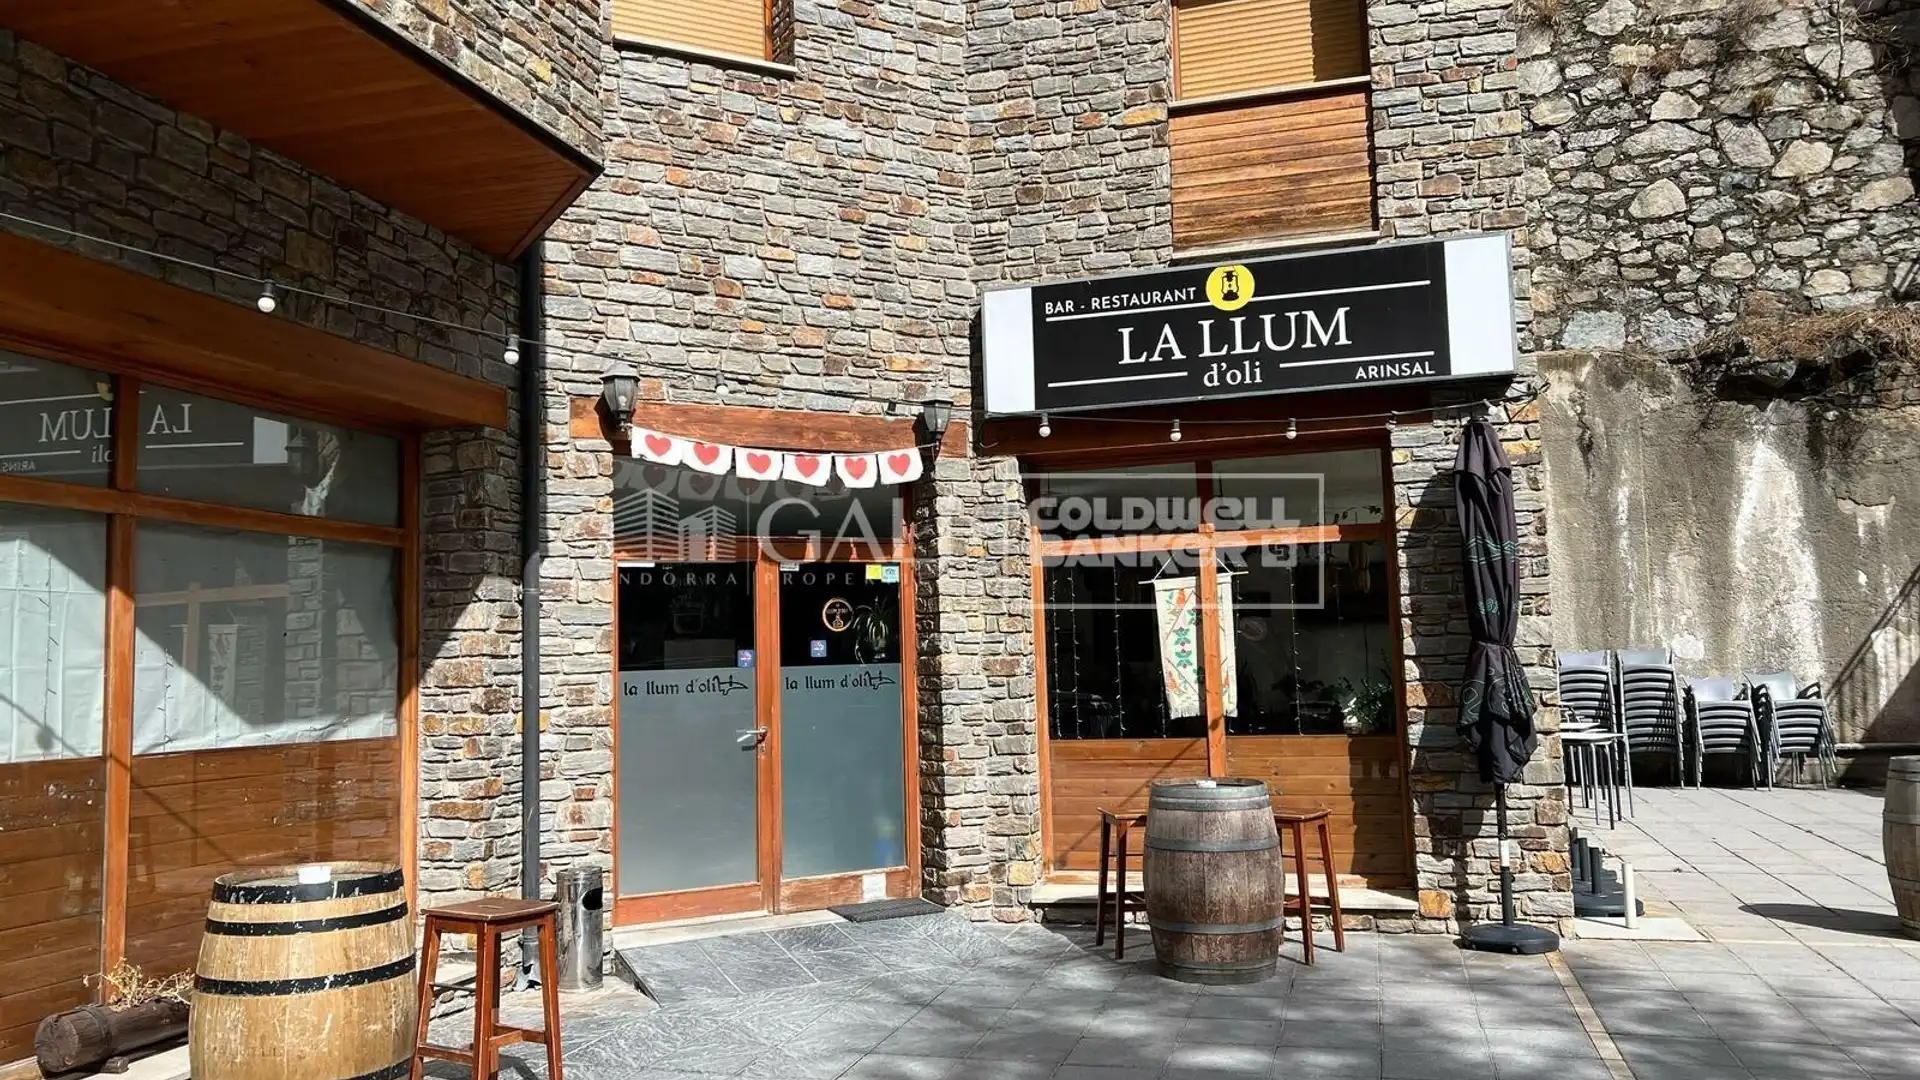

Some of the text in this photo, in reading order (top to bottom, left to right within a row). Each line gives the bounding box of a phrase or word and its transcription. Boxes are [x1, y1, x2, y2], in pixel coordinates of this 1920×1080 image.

[1045, 300, 1075, 315] BAR
[1091, 287, 1197, 310] RESTAURANT
[1118, 307, 1352, 366] LA LLUM
[1355, 361, 1436, 381] ARINSAL
[624, 681, 638, 696] la
[646, 680, 679, 695] llum
[785, 676, 798, 690] la
[805, 675, 835, 689] llum
